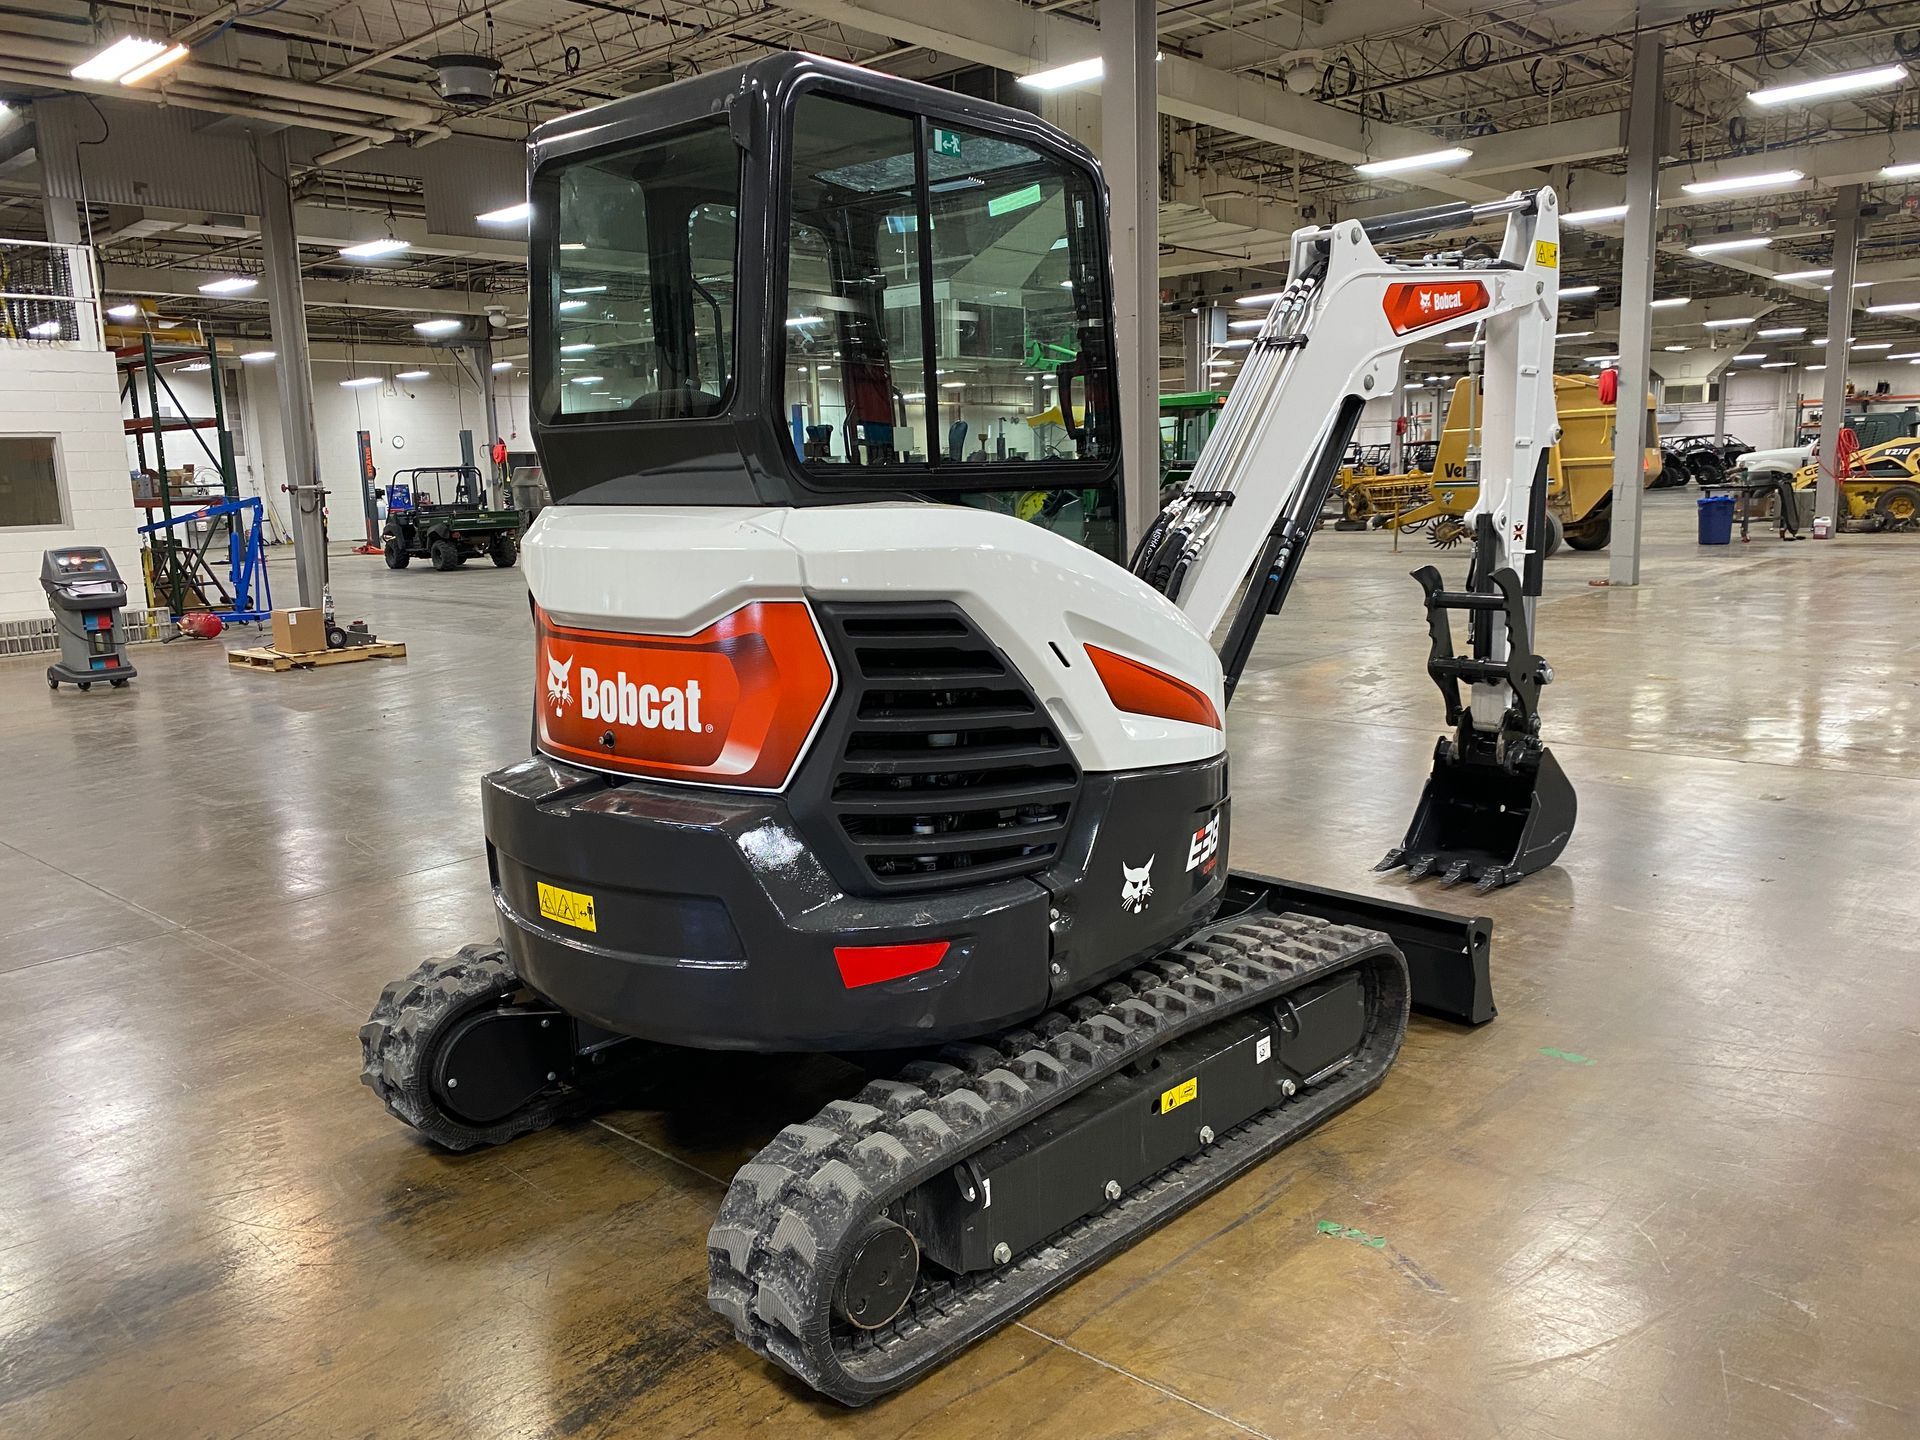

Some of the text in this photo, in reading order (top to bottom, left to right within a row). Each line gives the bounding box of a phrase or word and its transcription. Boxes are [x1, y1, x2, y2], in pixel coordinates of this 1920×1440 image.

[1433, 290, 1461, 311] Bobcat
[1884, 448, 1911, 456] V270
[580, 666, 702, 733] Bobcat
